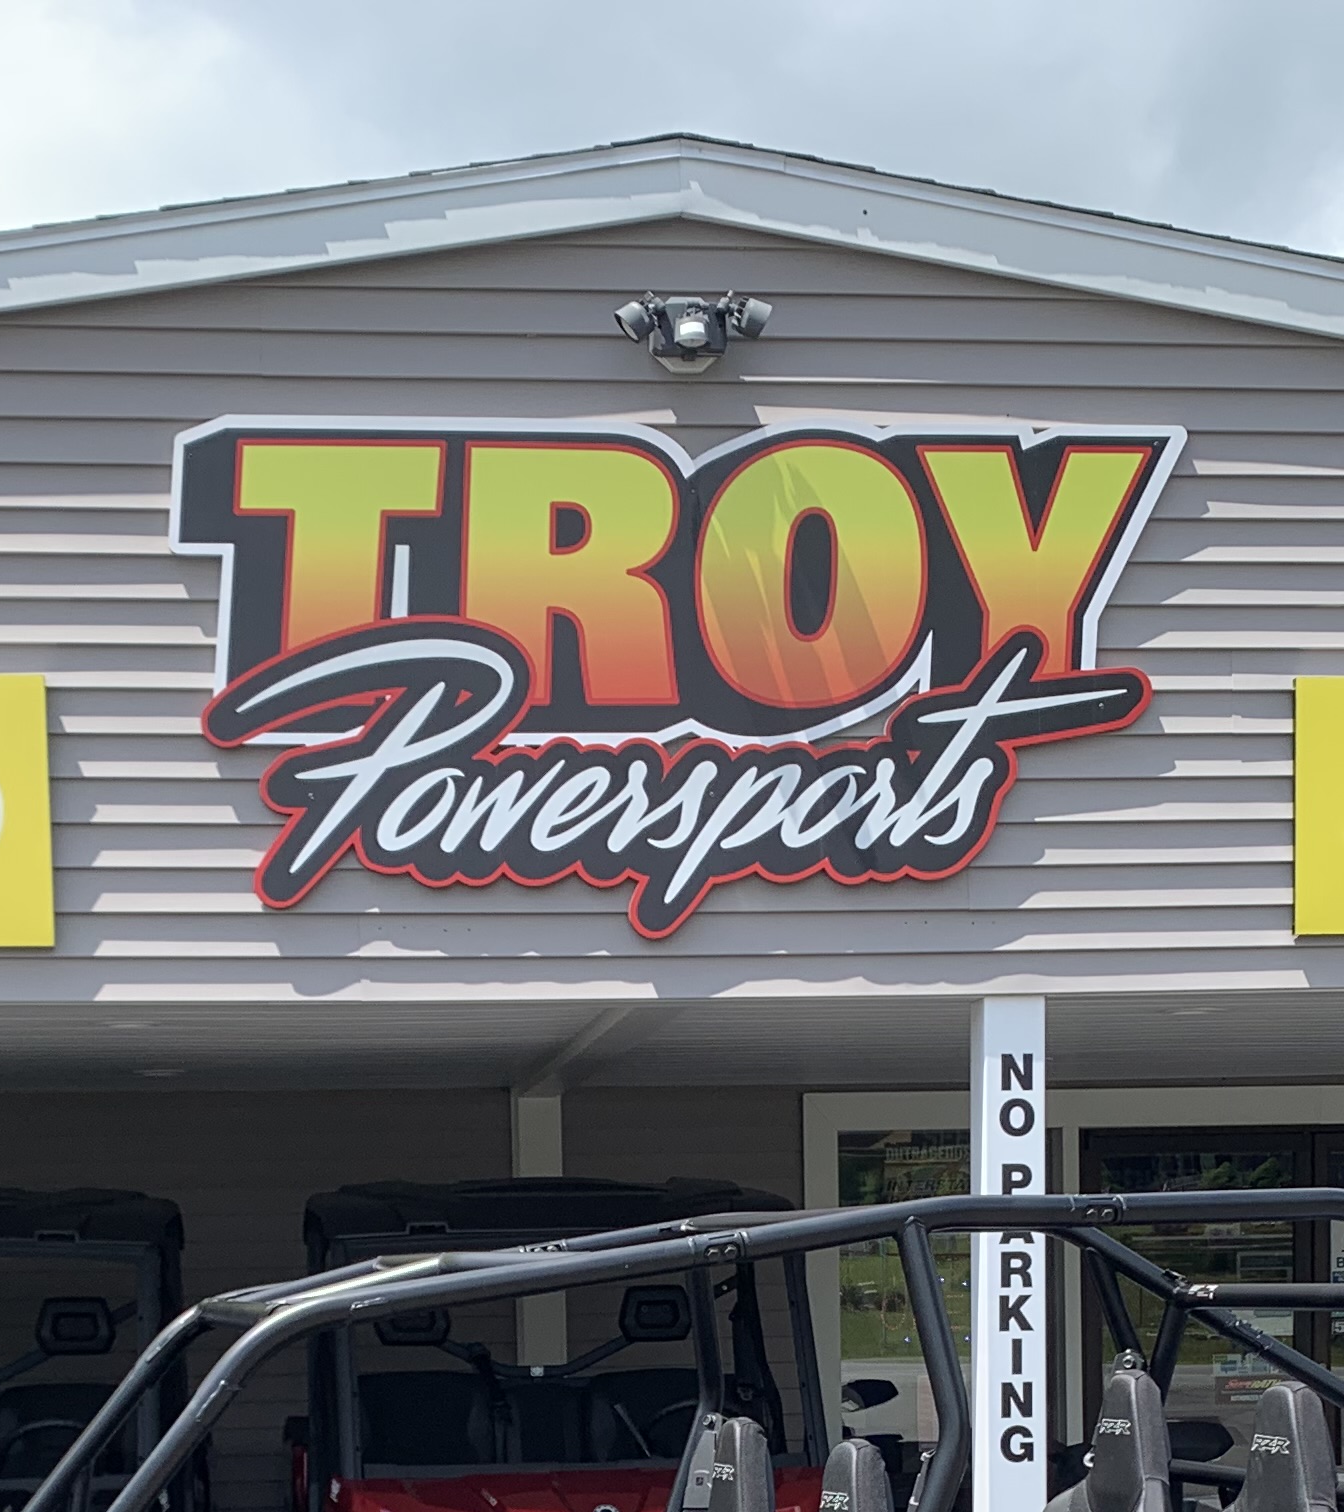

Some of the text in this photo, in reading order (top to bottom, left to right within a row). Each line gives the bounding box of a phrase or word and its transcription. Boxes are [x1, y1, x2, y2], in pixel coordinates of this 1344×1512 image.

[234, 438, 1152, 708] TROY
[235, 638, 1128, 905] Powersports
[999, 1053, 1035, 1137] NO
